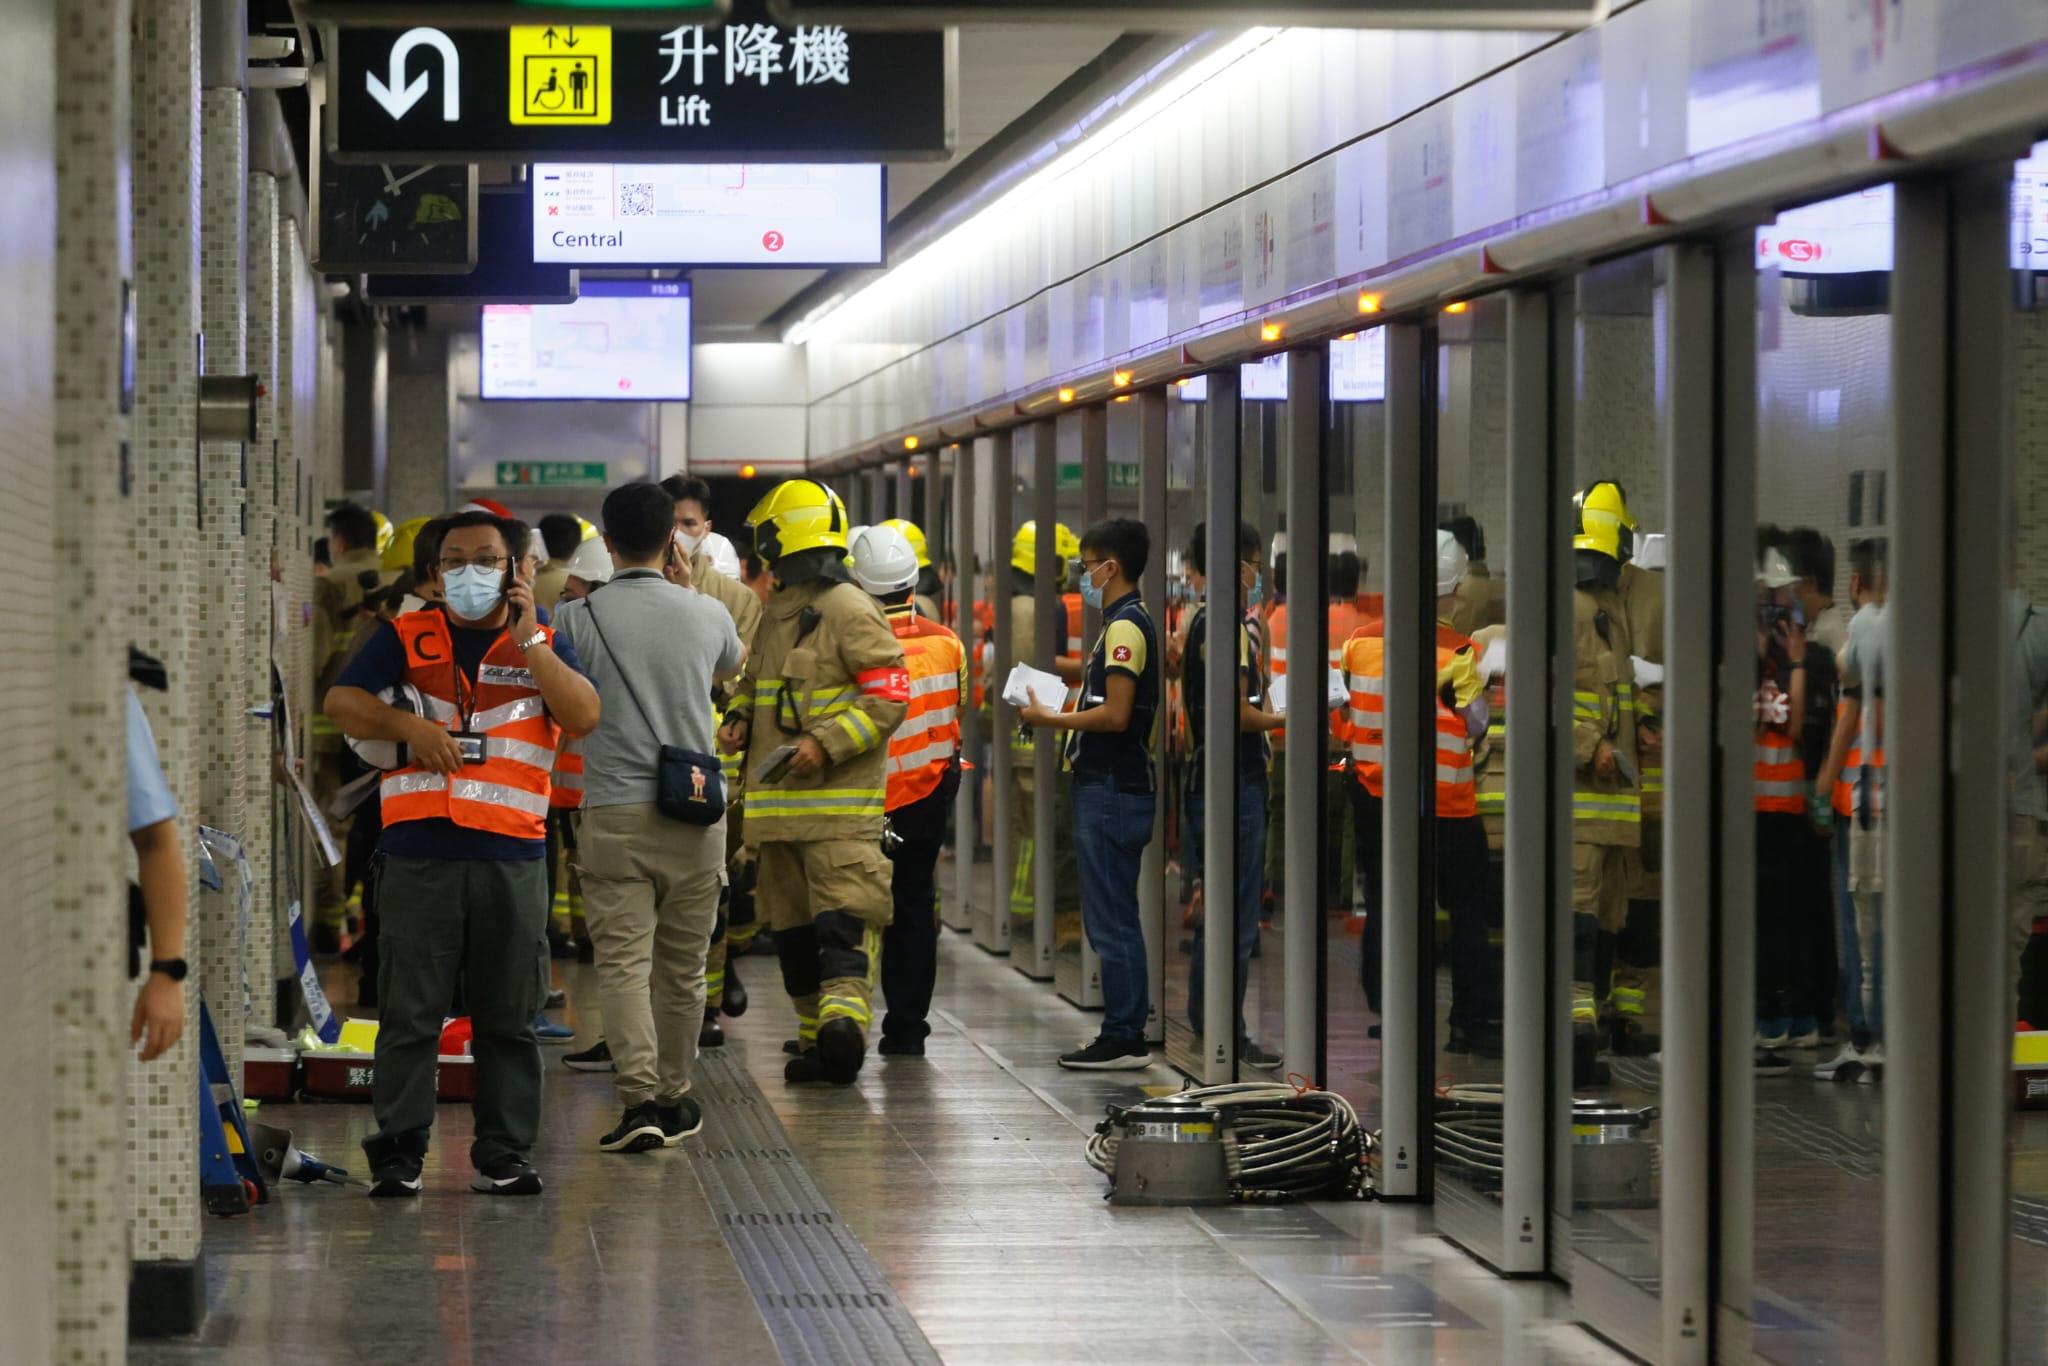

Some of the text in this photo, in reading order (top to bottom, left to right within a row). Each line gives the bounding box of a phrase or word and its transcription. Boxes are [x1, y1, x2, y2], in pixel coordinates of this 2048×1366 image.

[658, 23, 850, 86] 升降機
[660, 95, 711, 126] Lift
[552, 230, 623, 247] Central
[413, 631, 441, 660] C
